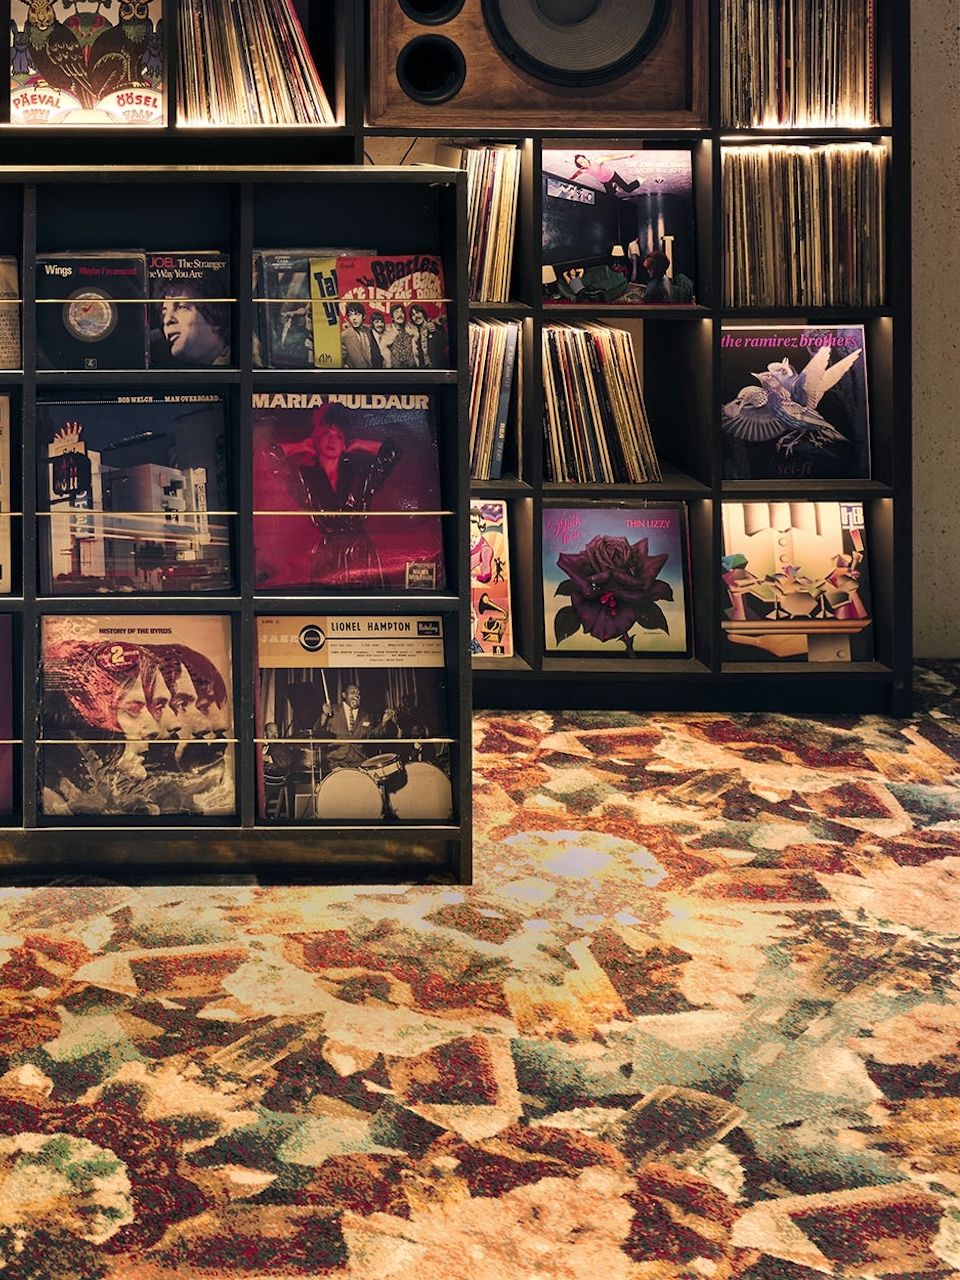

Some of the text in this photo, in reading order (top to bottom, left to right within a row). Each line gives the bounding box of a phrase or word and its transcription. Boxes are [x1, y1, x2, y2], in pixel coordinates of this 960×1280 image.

[13, 92, 158, 110] PÄEVAL ÖÖSEL
[44, 265, 73, 277] Wings
[150, 257, 226, 271] JOEL The Stranger
[156, 269, 174, 281] Way
[174, 269, 189, 278] You
[188, 270, 203, 278] Are
[388, 274, 412, 293] GET
[720, 332, 858, 348] the ramirez brothers
[251, 393, 430, 410] MARIA MULDAUR
[625, 519, 670, 528] THIN LIZZY
[331, 622, 361, 632] LIONEL
[368, 622, 411, 631] HAMPTON
[110, 646, 125, 664] 2
